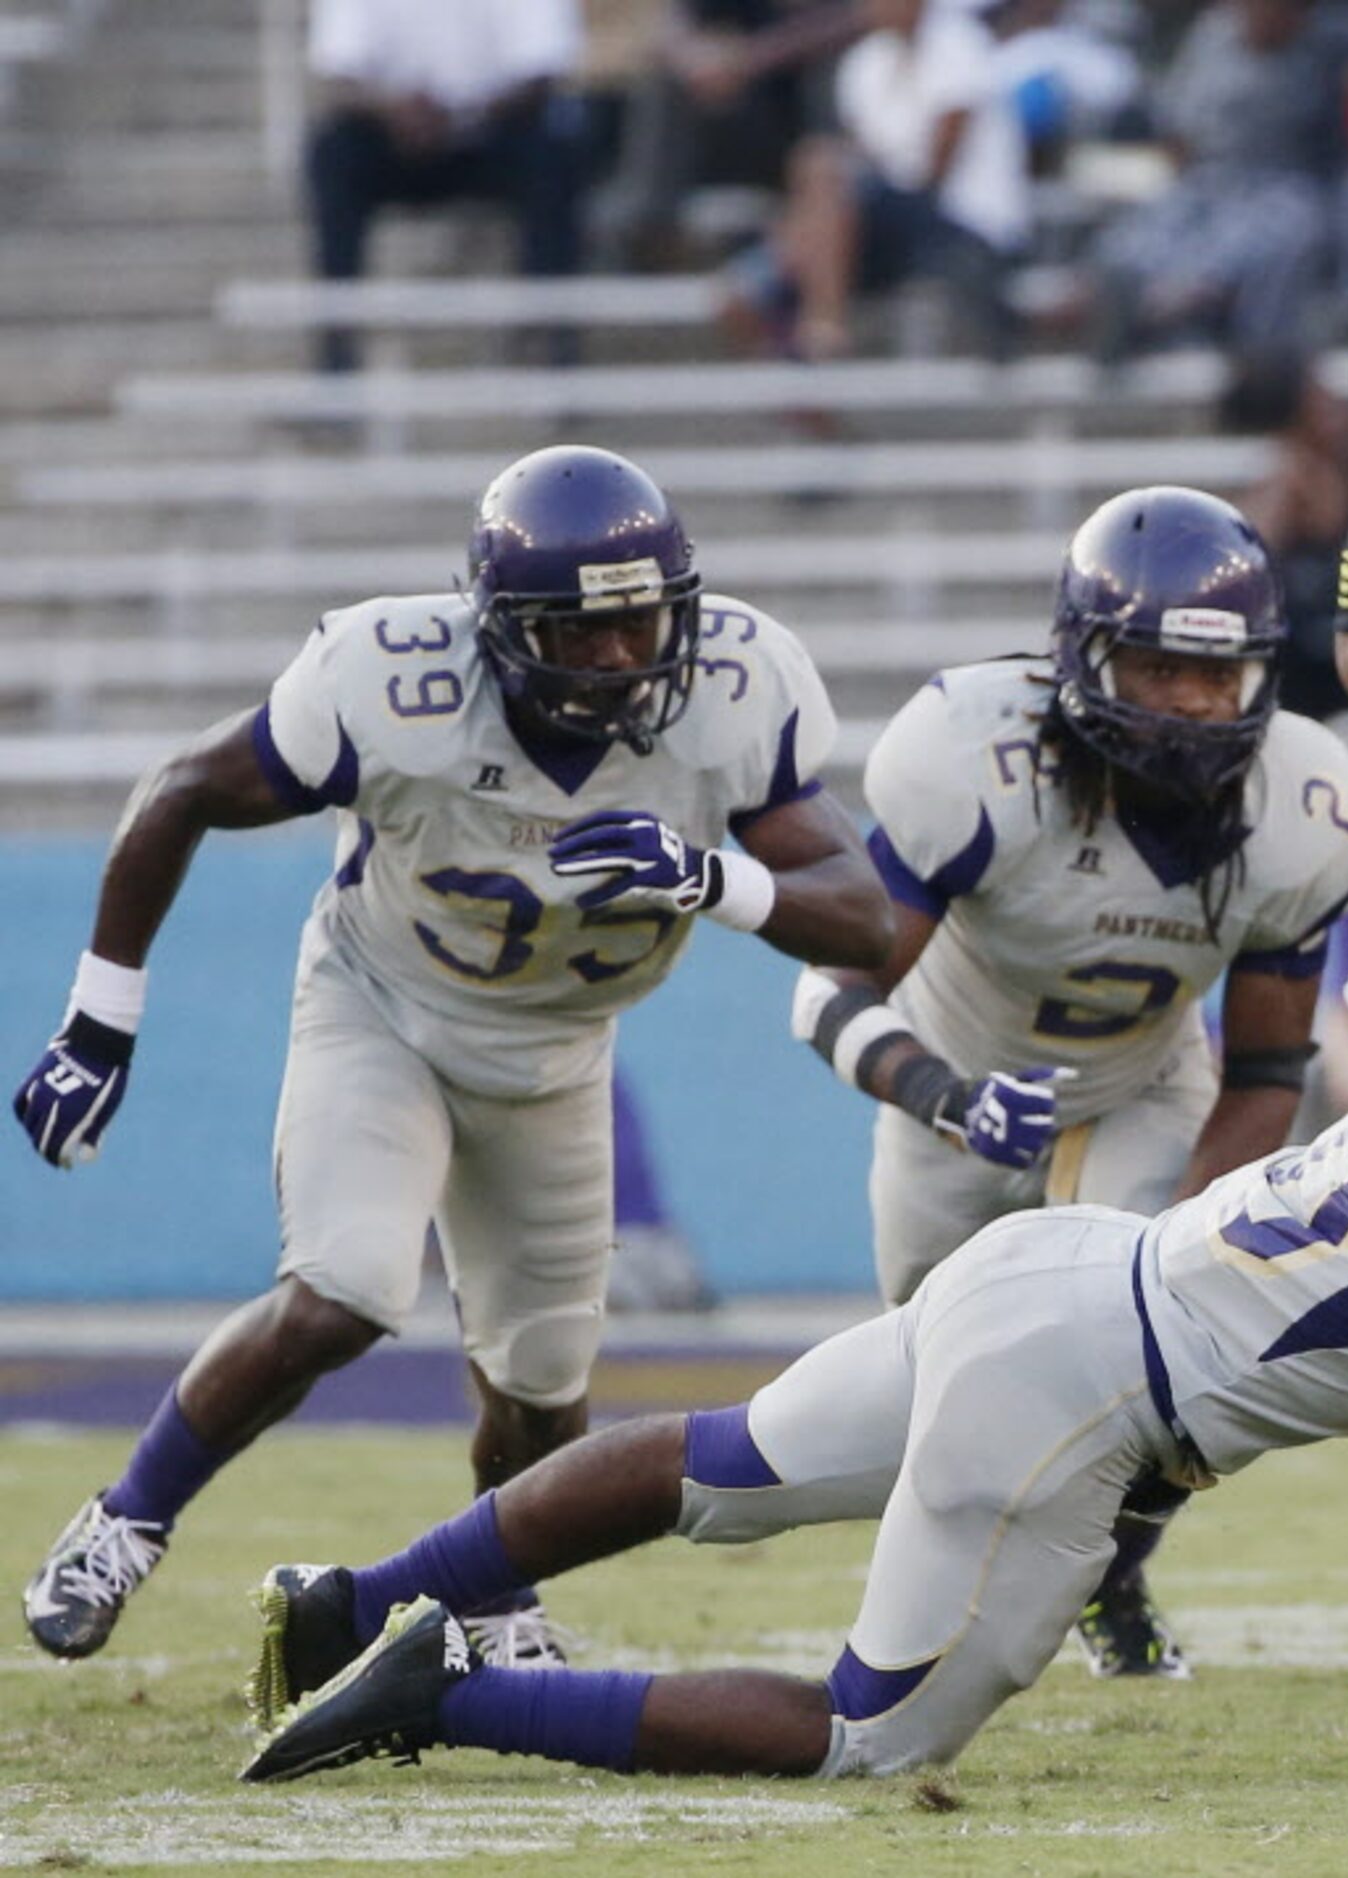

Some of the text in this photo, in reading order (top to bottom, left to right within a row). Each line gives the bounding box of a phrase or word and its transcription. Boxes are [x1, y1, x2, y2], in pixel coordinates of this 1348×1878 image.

[375, 615, 464, 722] 39
[1033, 960, 1184, 1044] 2
[443, 1613, 471, 1674] NIKE
